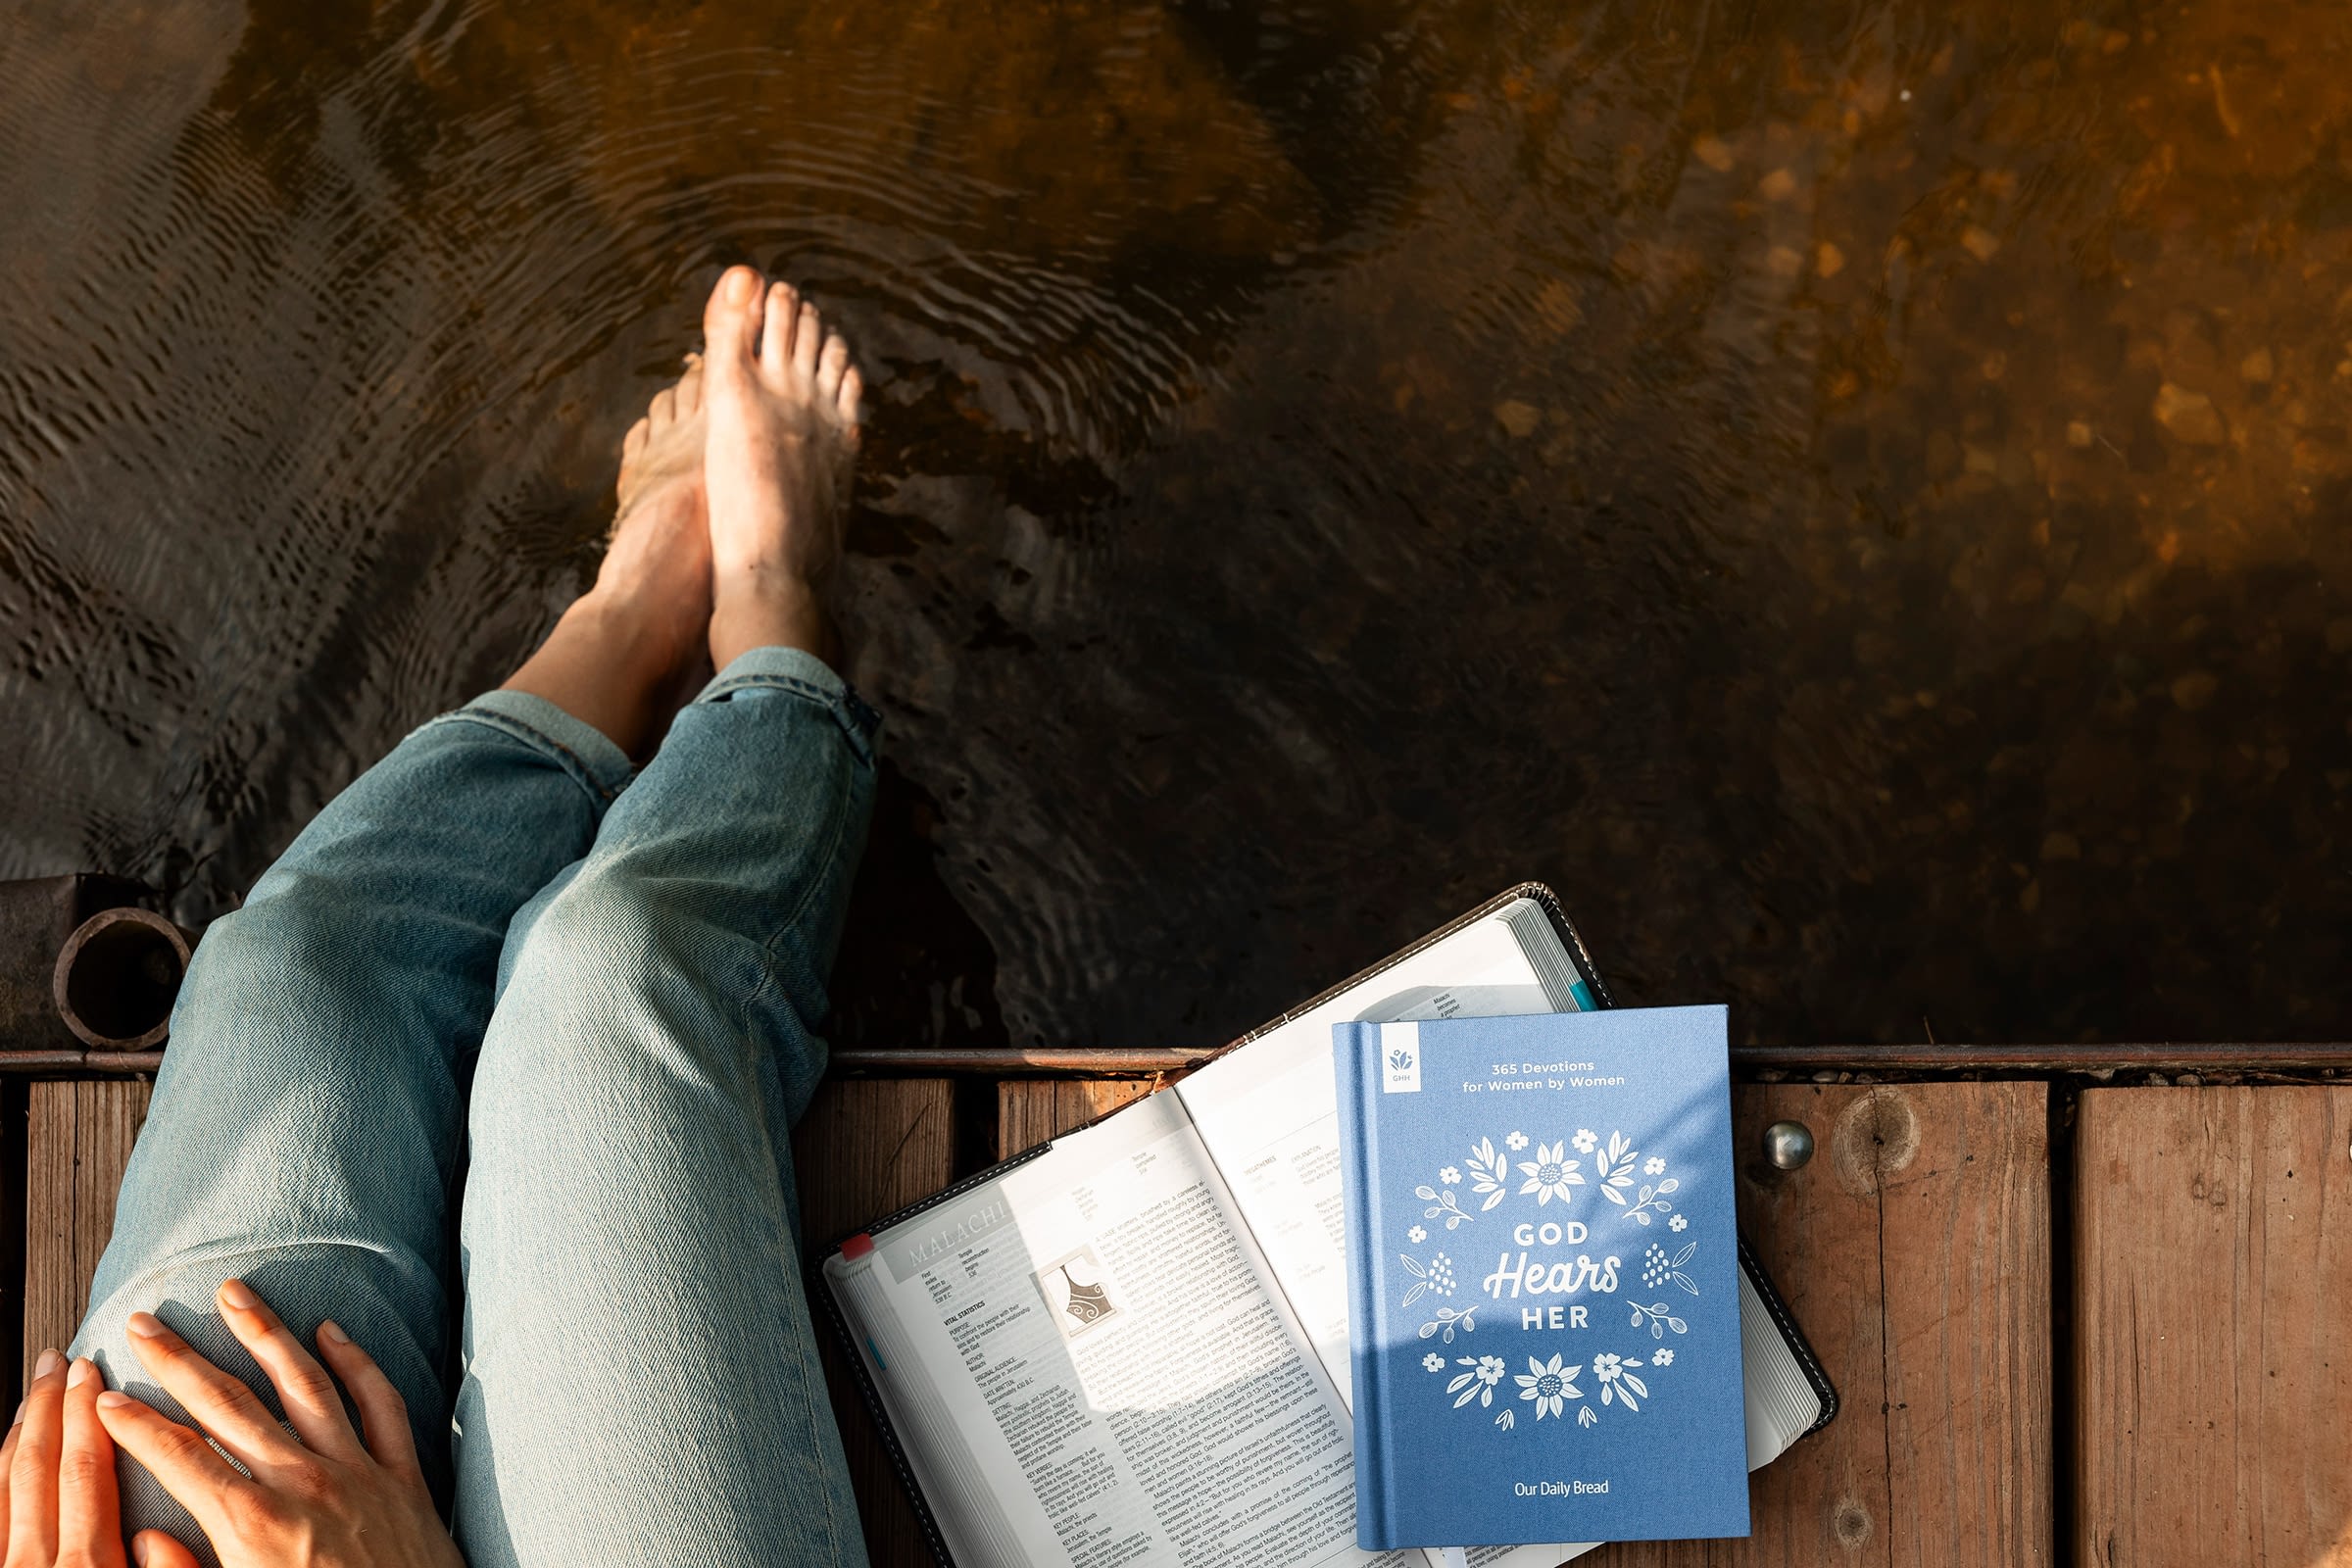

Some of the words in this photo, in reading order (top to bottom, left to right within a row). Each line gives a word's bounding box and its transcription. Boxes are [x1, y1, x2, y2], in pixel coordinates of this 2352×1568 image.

[1463, 1082, 1482, 1092] for
[1489, 1081, 1542, 1091] Women
[1548, 1078, 1564, 1090] by
[1570, 1077, 1624, 1087] Women
[1493, 1064, 1517, 1074] 365
[1523, 1061, 1593, 1073] Devotions
[908, 1200, 1006, 1265] MALACHI
[1514, 1222, 1587, 1246] GOD
[1484, 1252, 1620, 1298] Hears
[1522, 1306, 1588, 1330] HER
[1122, 1445, 1136, 1454] laws
[1161, 1421, 1178, 1434] called
[1178, 1416, 1188, 1425] evil
[1223, 1390, 1237, 1399] kept
[1252, 1373, 1269, 1384] tithes
[1268, 1366, 1280, 1376] and
[1280, 1355, 1301, 1370] offerings
[1131, 1461, 1144, 1470] ship
[1175, 1437, 1187, 1446] and
[1186, 1424, 1211, 1443] judgment
[1211, 1418, 1223, 1428] and
[1223, 1401, 1254, 1422] punishment
[1254, 1392, 1272, 1404] would
[1136, 1439, 1166, 1457] themselves
[1188, 1420, 1199, 1430] and
[1200, 1409, 1222, 1423] become
[1223, 1396, 1246, 1411] arrogant
[1140, 1475, 1155, 1487] loved
[1155, 1468, 1166, 1478] and
[1166, 1456, 1189, 1472] honored
[1203, 1442, 1216, 1452] God
[1216, 1433, 1234, 1445] would
[1234, 1422, 1254, 1436] shower
[1264, 1403, 1291, 1420] blessings
[1290, 1396, 1304, 1405] upon
[1303, 1388, 1319, 1398] these
[1153, 1486, 1175, 1499] Malachi
[1175, 1477, 1192, 1490] paints
[1196, 1462, 1220, 1477] stunning
[1219, 1452, 1238, 1466] picture
[1263, 1418, 1300, 1442] unfaithfulness
[1299, 1412, 1311, 1421] that
[1310, 1403, 1329, 1415] clearly
[1167, 1497, 1192, 1513] message
[1226, 1465, 1253, 1483] possibility
[1292, 1437, 1305, 1446] This
[1309, 1418, 1338, 1437] beautifully
[1145, 1485, 1157, 1494] men
[1156, 1478, 1168, 1488] and
[1167, 1468, 1188, 1482] women
[1179, 1534, 1200, 1547] Malachi
[1202, 1519, 1230, 1536] concludes
[1231, 1512, 1243, 1521] with
[1250, 1497, 1272, 1512] promise
[1293, 1475, 1313, 1489] coming
[1334, 1449, 1355, 1467] prophet
[1197, 1541, 1209, 1549] who
[1209, 1534, 1218, 1543] will
[1218, 1529, 1230, 1538] offer
[1247, 1504, 1278, 1522] forgiveness
[1292, 1487, 1310, 1500] people
[1309, 1475, 1331, 1490] through
[1330, 1458, 1357, 1478] repentanc
[1515, 1483, 1537, 1495] Our
[1542, 1482, 1570, 1497] Daily
[1574, 1480, 1608, 1494] Bread
